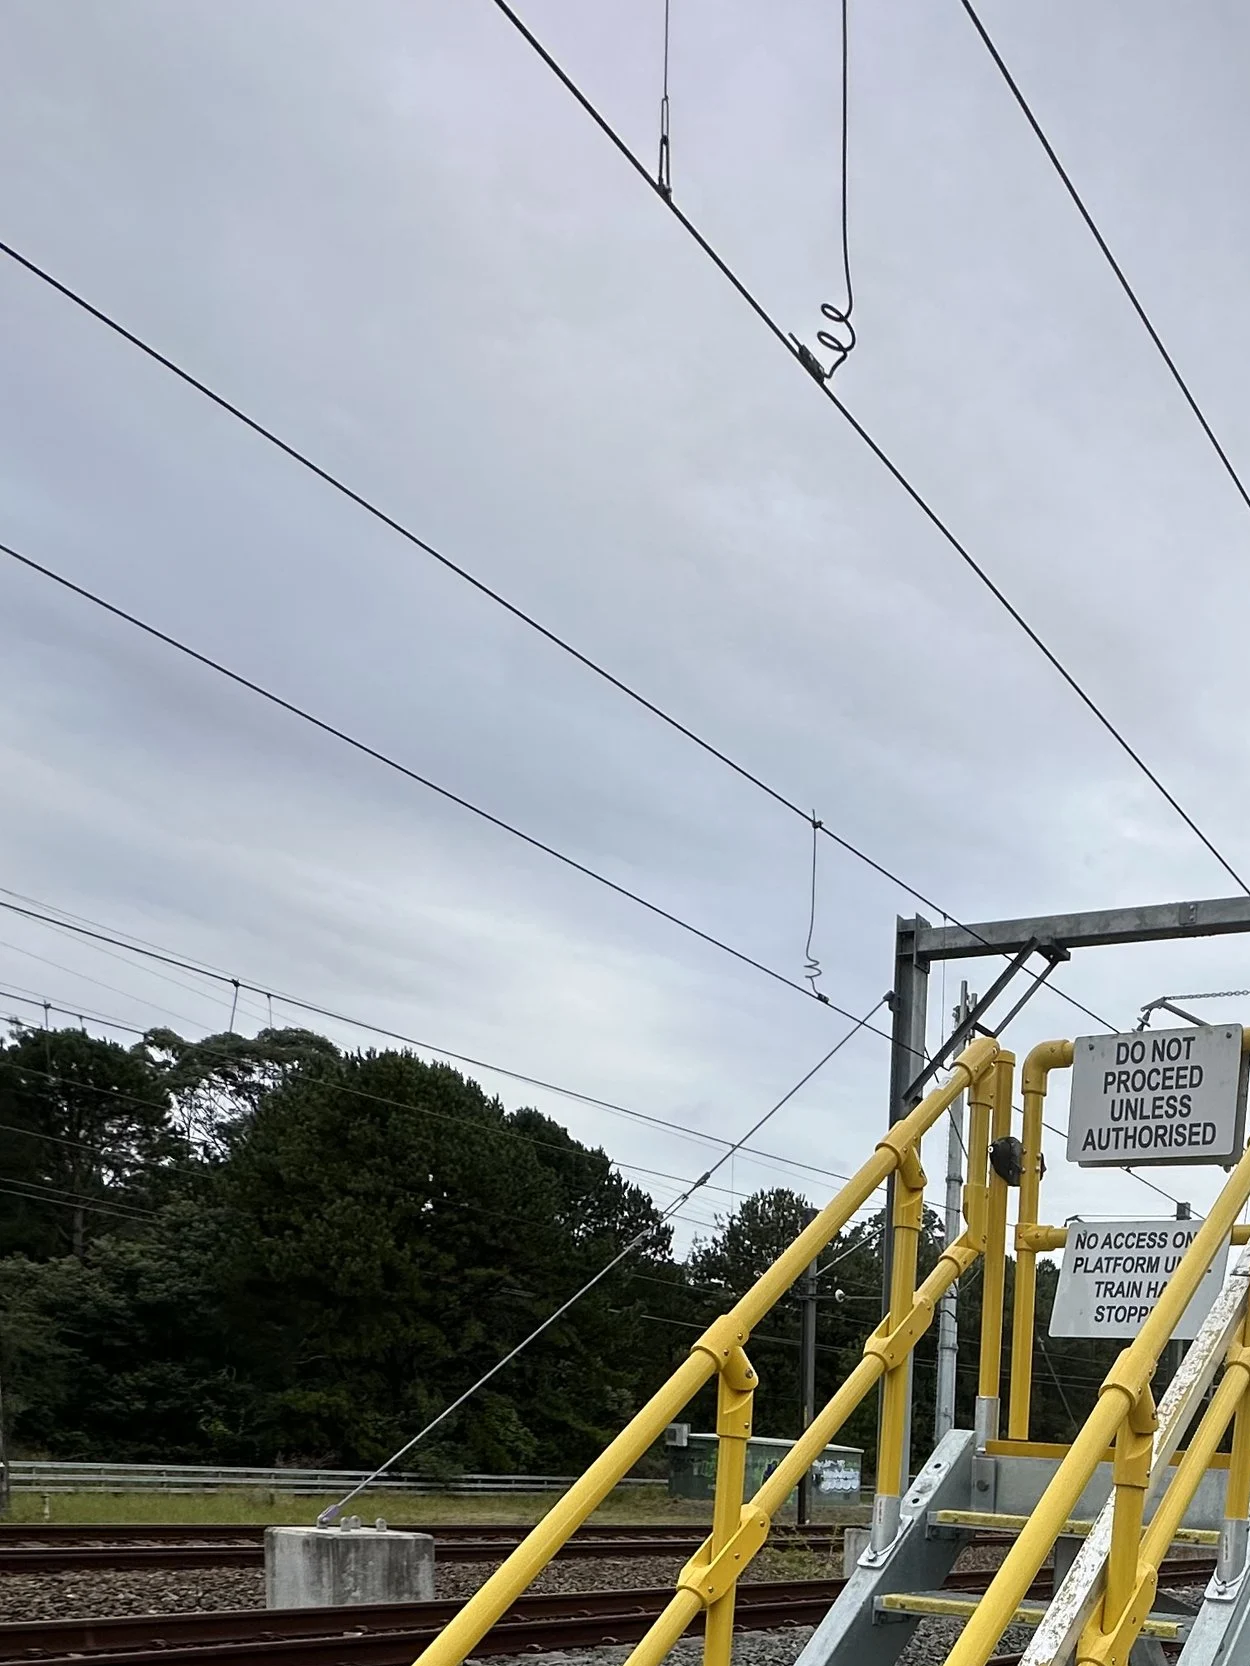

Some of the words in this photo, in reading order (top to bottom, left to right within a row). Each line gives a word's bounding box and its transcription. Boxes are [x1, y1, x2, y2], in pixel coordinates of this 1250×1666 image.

[1116, 1041, 1146, 1065] DO
[1151, 1036, 1196, 1063] NOT
[1104, 1065, 1203, 1094] PROCEED
[1111, 1094, 1192, 1122] UNLESS
[1082, 1122, 1216, 1151] AUTHORISED
[1075, 1233, 1099, 1250] NO
[1101, 1231, 1168, 1249] ACCESS
[1073, 1256, 1160, 1273] PLATFORM
[1095, 1281, 1143, 1298] TRAIN
[1094, 1305, 1154, 1323] STOPP
